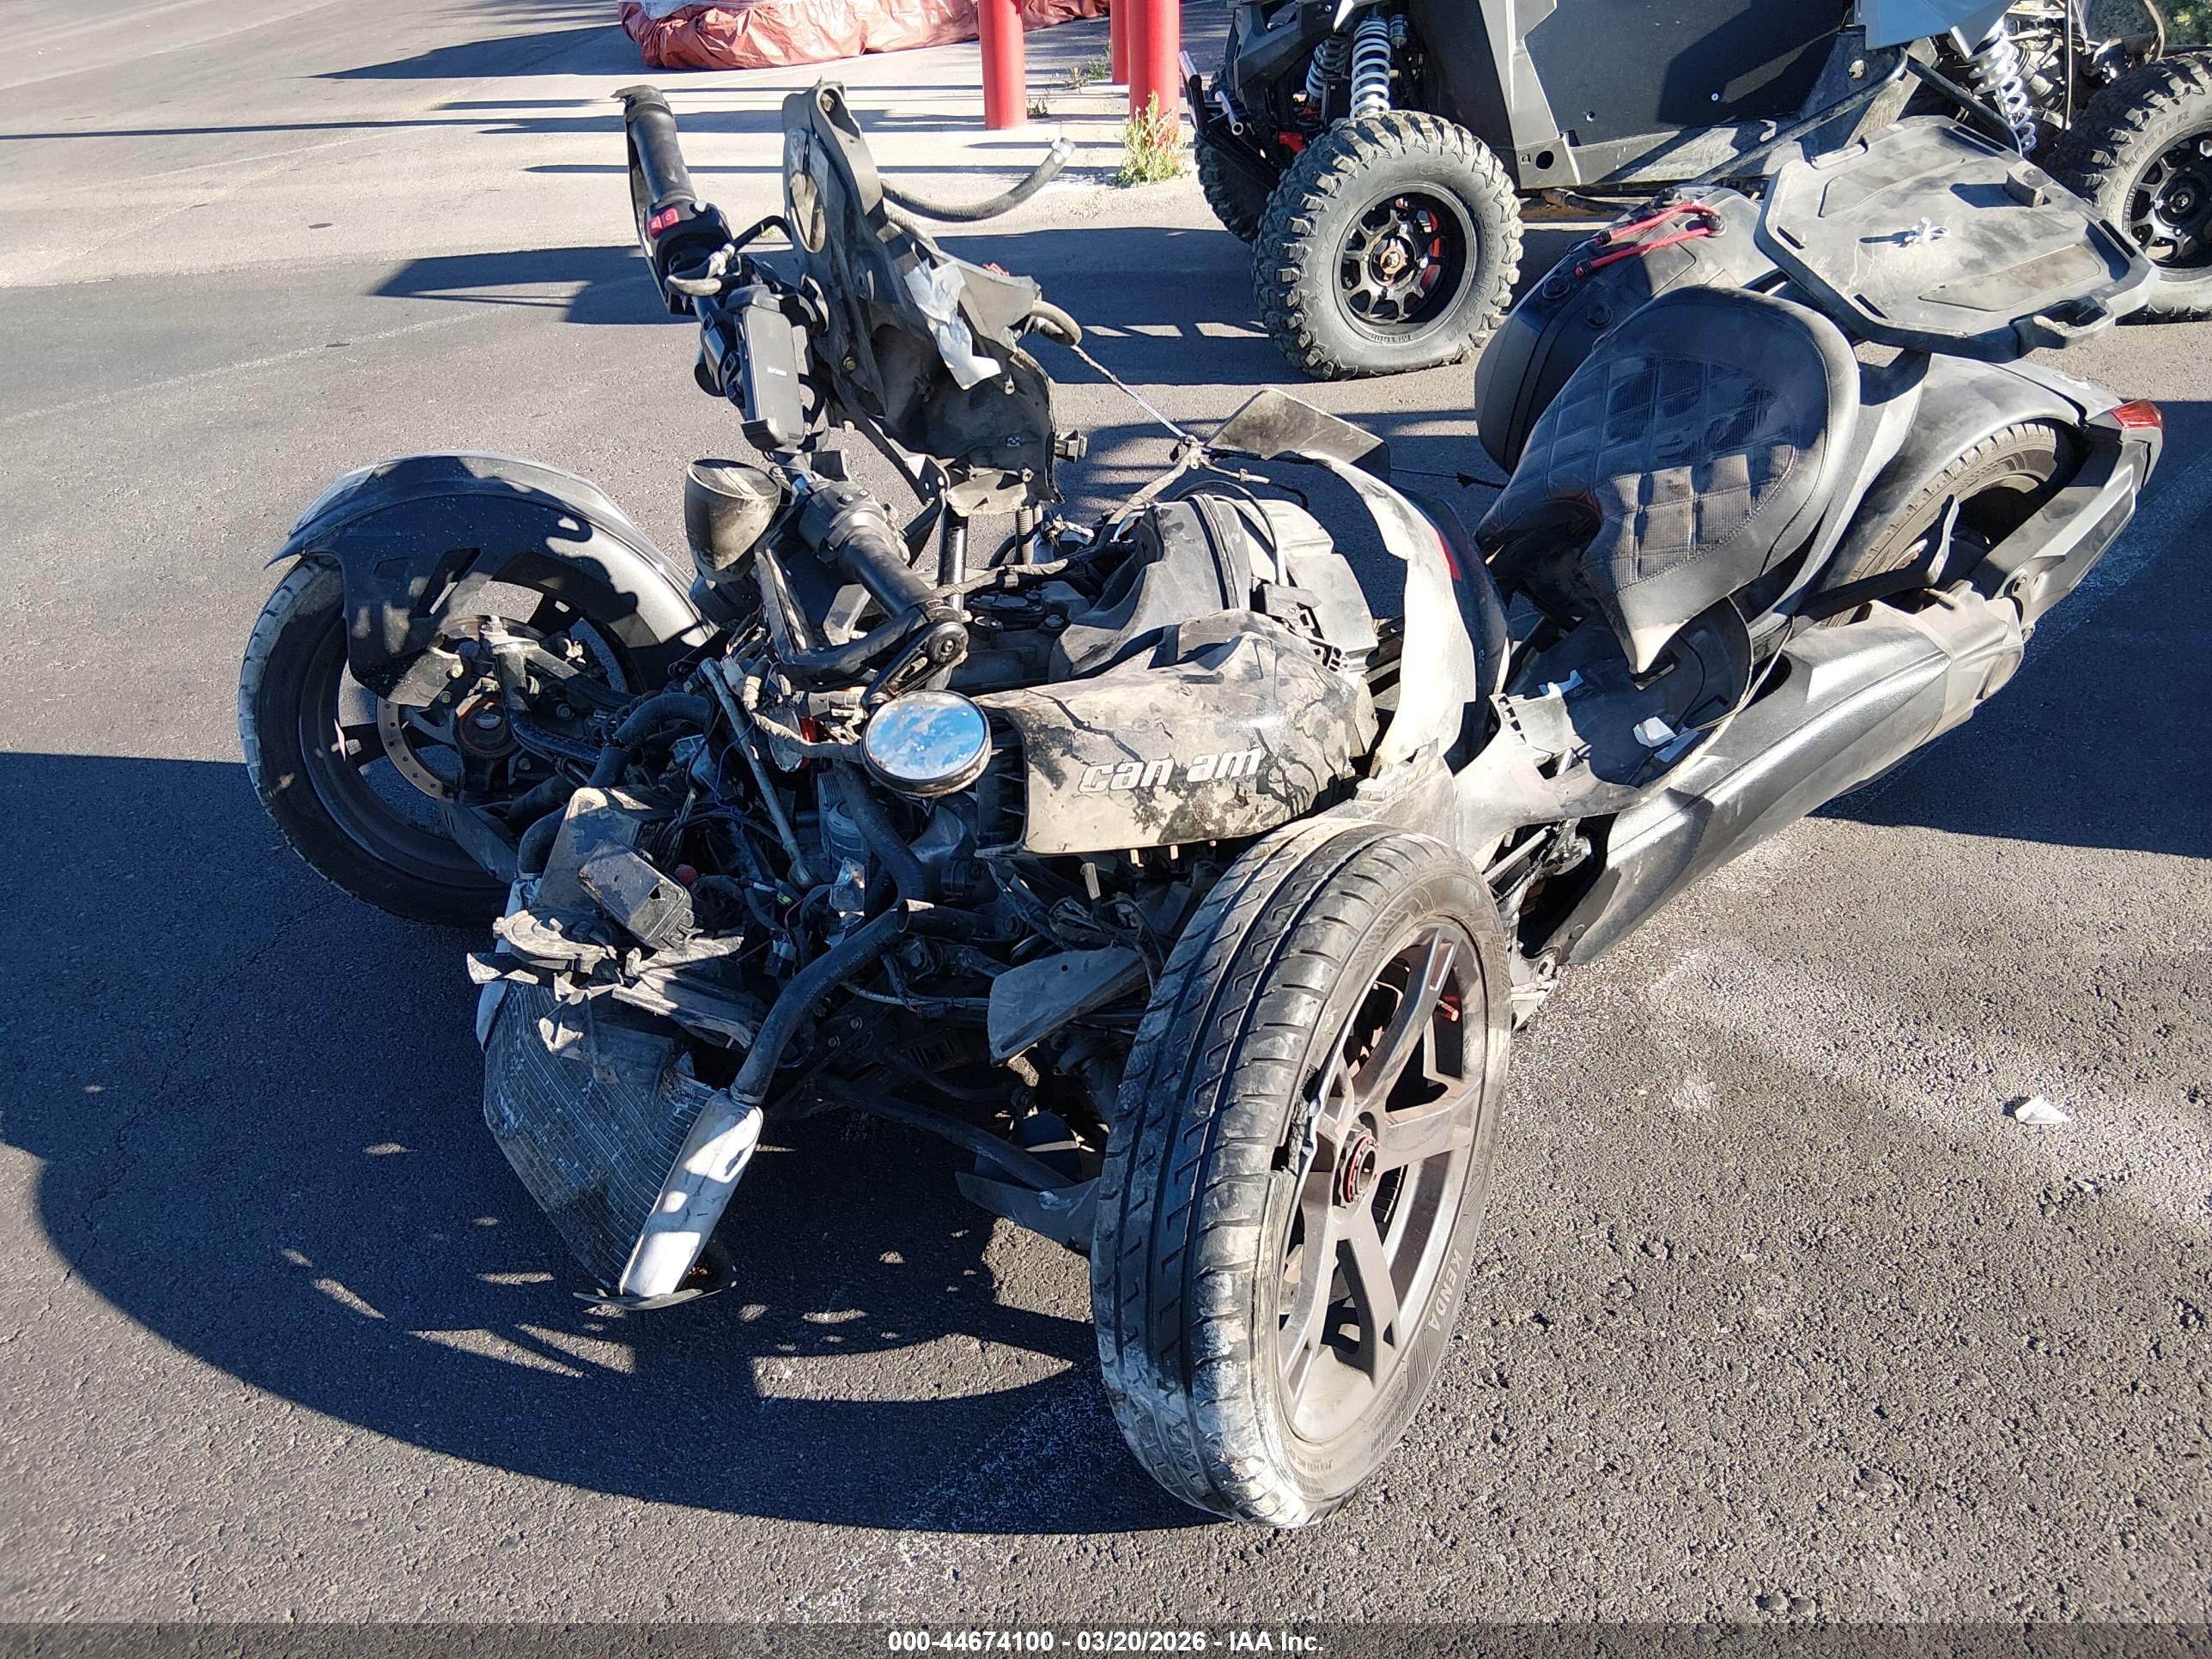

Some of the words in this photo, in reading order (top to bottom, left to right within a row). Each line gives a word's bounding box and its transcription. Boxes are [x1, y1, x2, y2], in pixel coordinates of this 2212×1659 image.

[1079, 756, 1175, 793] can
[1186, 749, 1262, 782] am
[1428, 1249, 1463, 1331] KENDA
